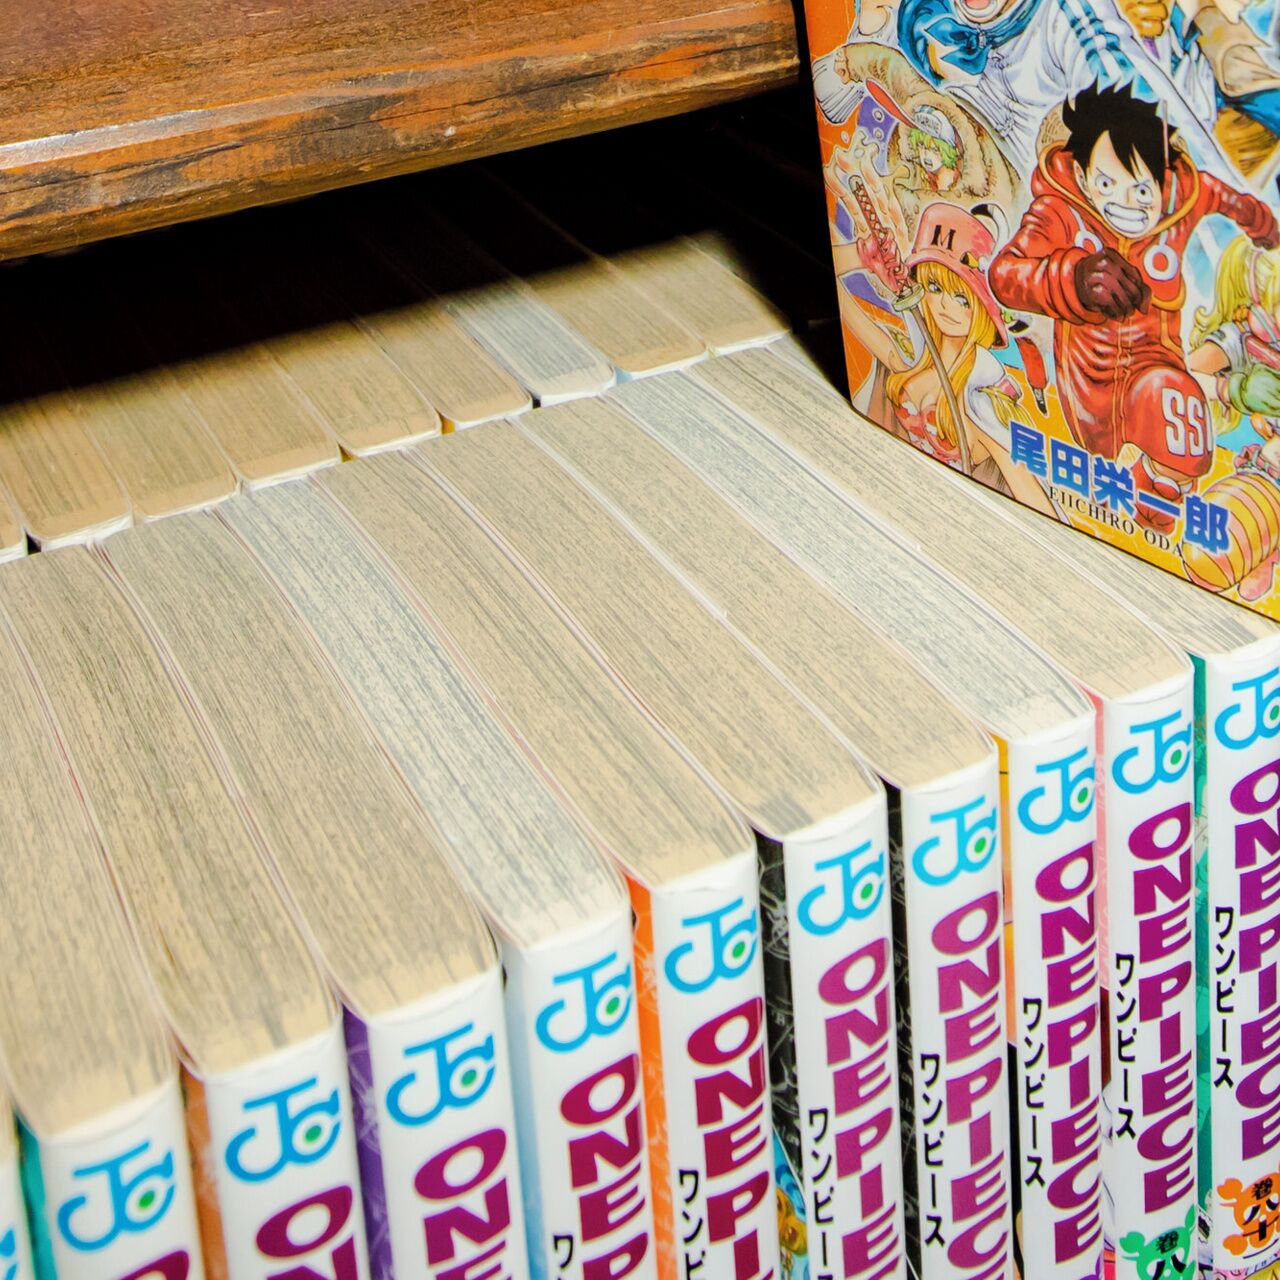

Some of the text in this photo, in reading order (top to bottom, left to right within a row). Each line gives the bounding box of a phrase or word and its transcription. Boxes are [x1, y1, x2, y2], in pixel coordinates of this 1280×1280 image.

[1009, 421, 1230, 554] 尾田栄一郎
[1162, 387, 1213, 457] SS
[1048, 485, 1185, 558] EIICHIRO ODA
[818, 936, 893, 1119] ONE
[931, 891, 1002, 1066] ONE
[1035, 841, 1101, 1265] ONE PIECE
[1114, 953, 1137, 1140] ワンピース
[1127, 802, 1196, 1214] ONE PIECE
[1213, 905, 1238, 1088] ワンピース
[686, 996, 770, 1183] ONE
[919, 1053, 947, 1247] ワンピース
[1022, 997, 1046, 1188] ワンピース
